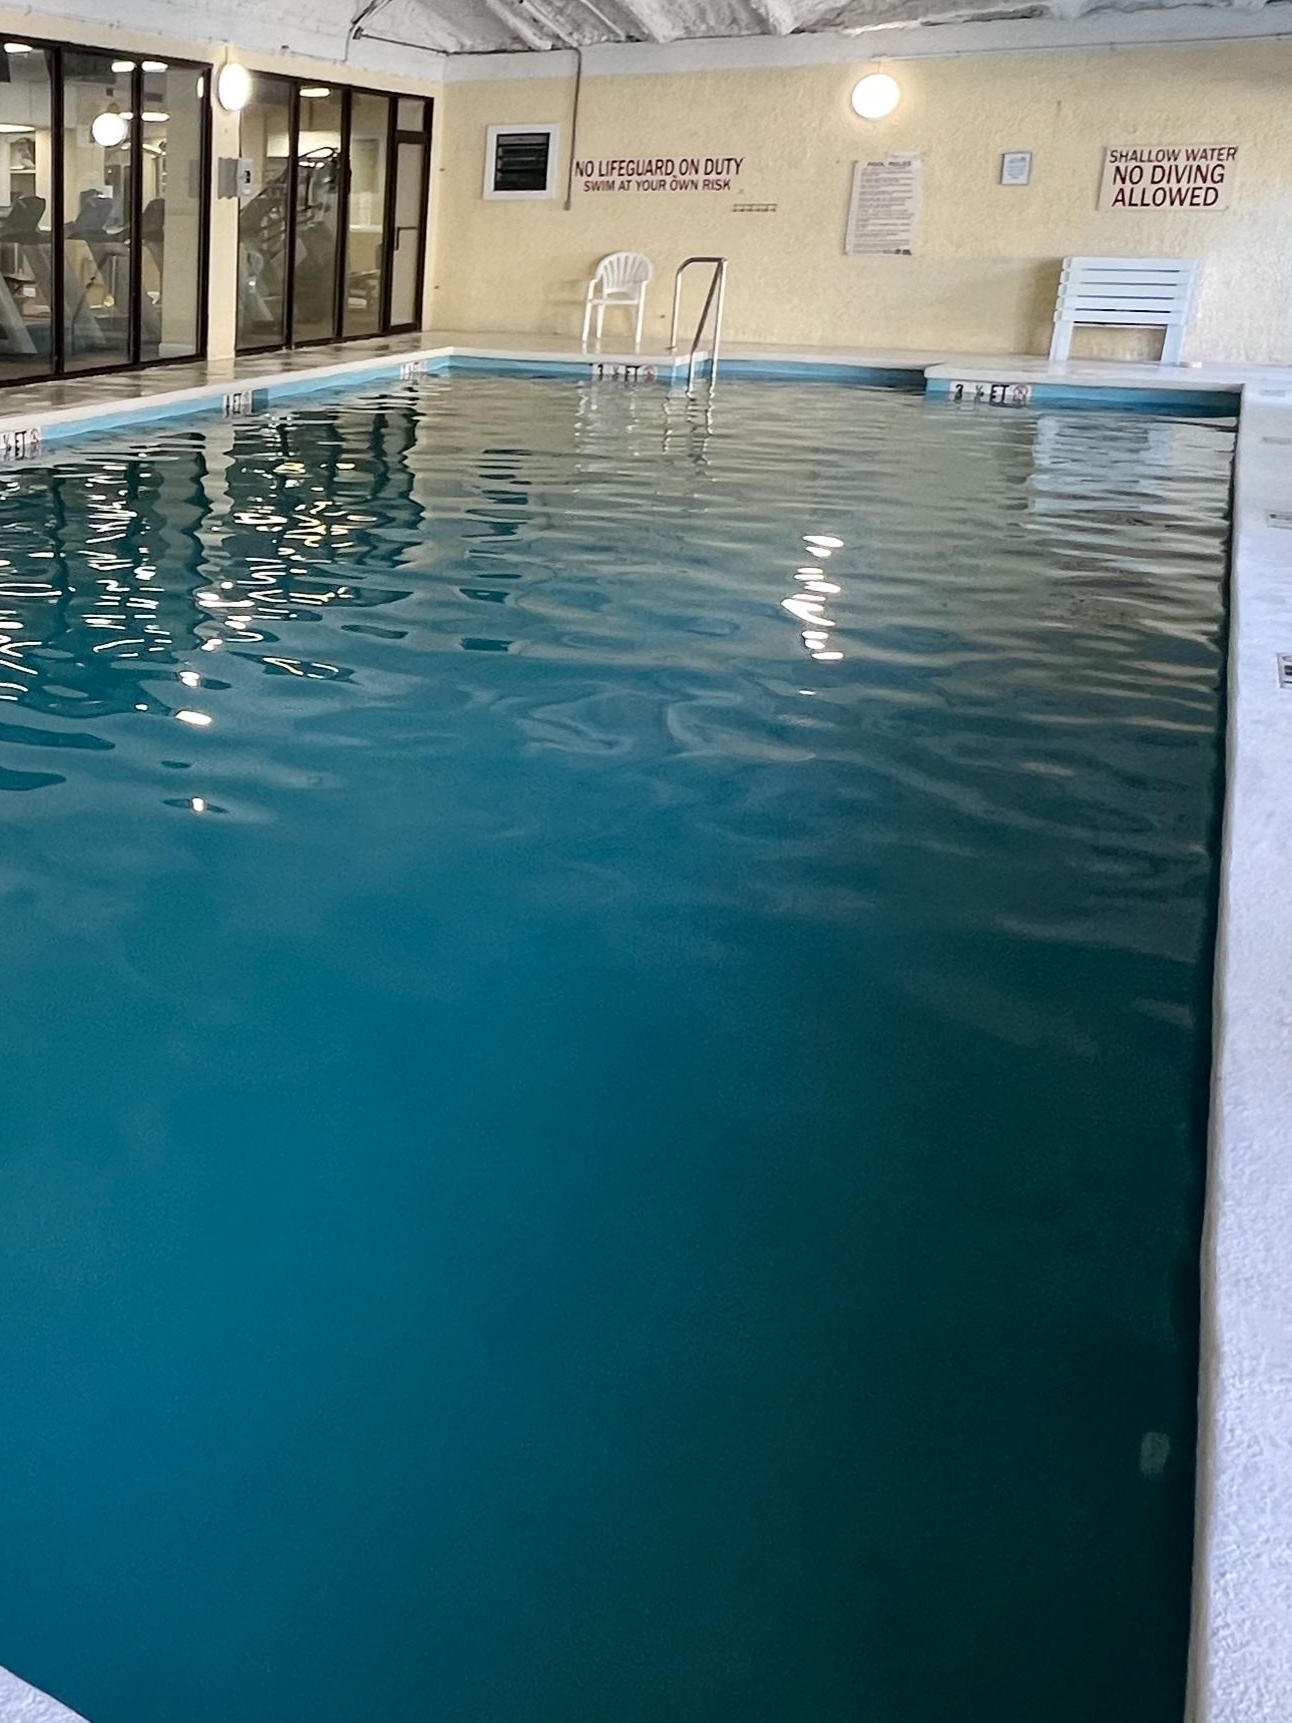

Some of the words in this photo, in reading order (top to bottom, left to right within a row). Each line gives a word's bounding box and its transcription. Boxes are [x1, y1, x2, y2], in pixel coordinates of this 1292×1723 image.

[1109, 148, 1181, 164] SHALLOW
[1185, 146, 1238, 162] WATER
[575, 160, 594, 178] NO
[598, 159, 675, 177] LIFEGUARD
[679, 158, 700, 176] ON
[704, 157, 744, 176] DUTY
[1113, 165, 1144, 186] NO
[1150, 164, 1226, 186] DIVING
[583, 180, 615, 192] SWIM
[617, 179, 632, 192] AT
[635, 179, 665, 192] YOUR
[670, 179, 699, 192] OWN
[702, 178, 731, 191] RISK
[1112, 186, 1219, 208] ALLOWED
